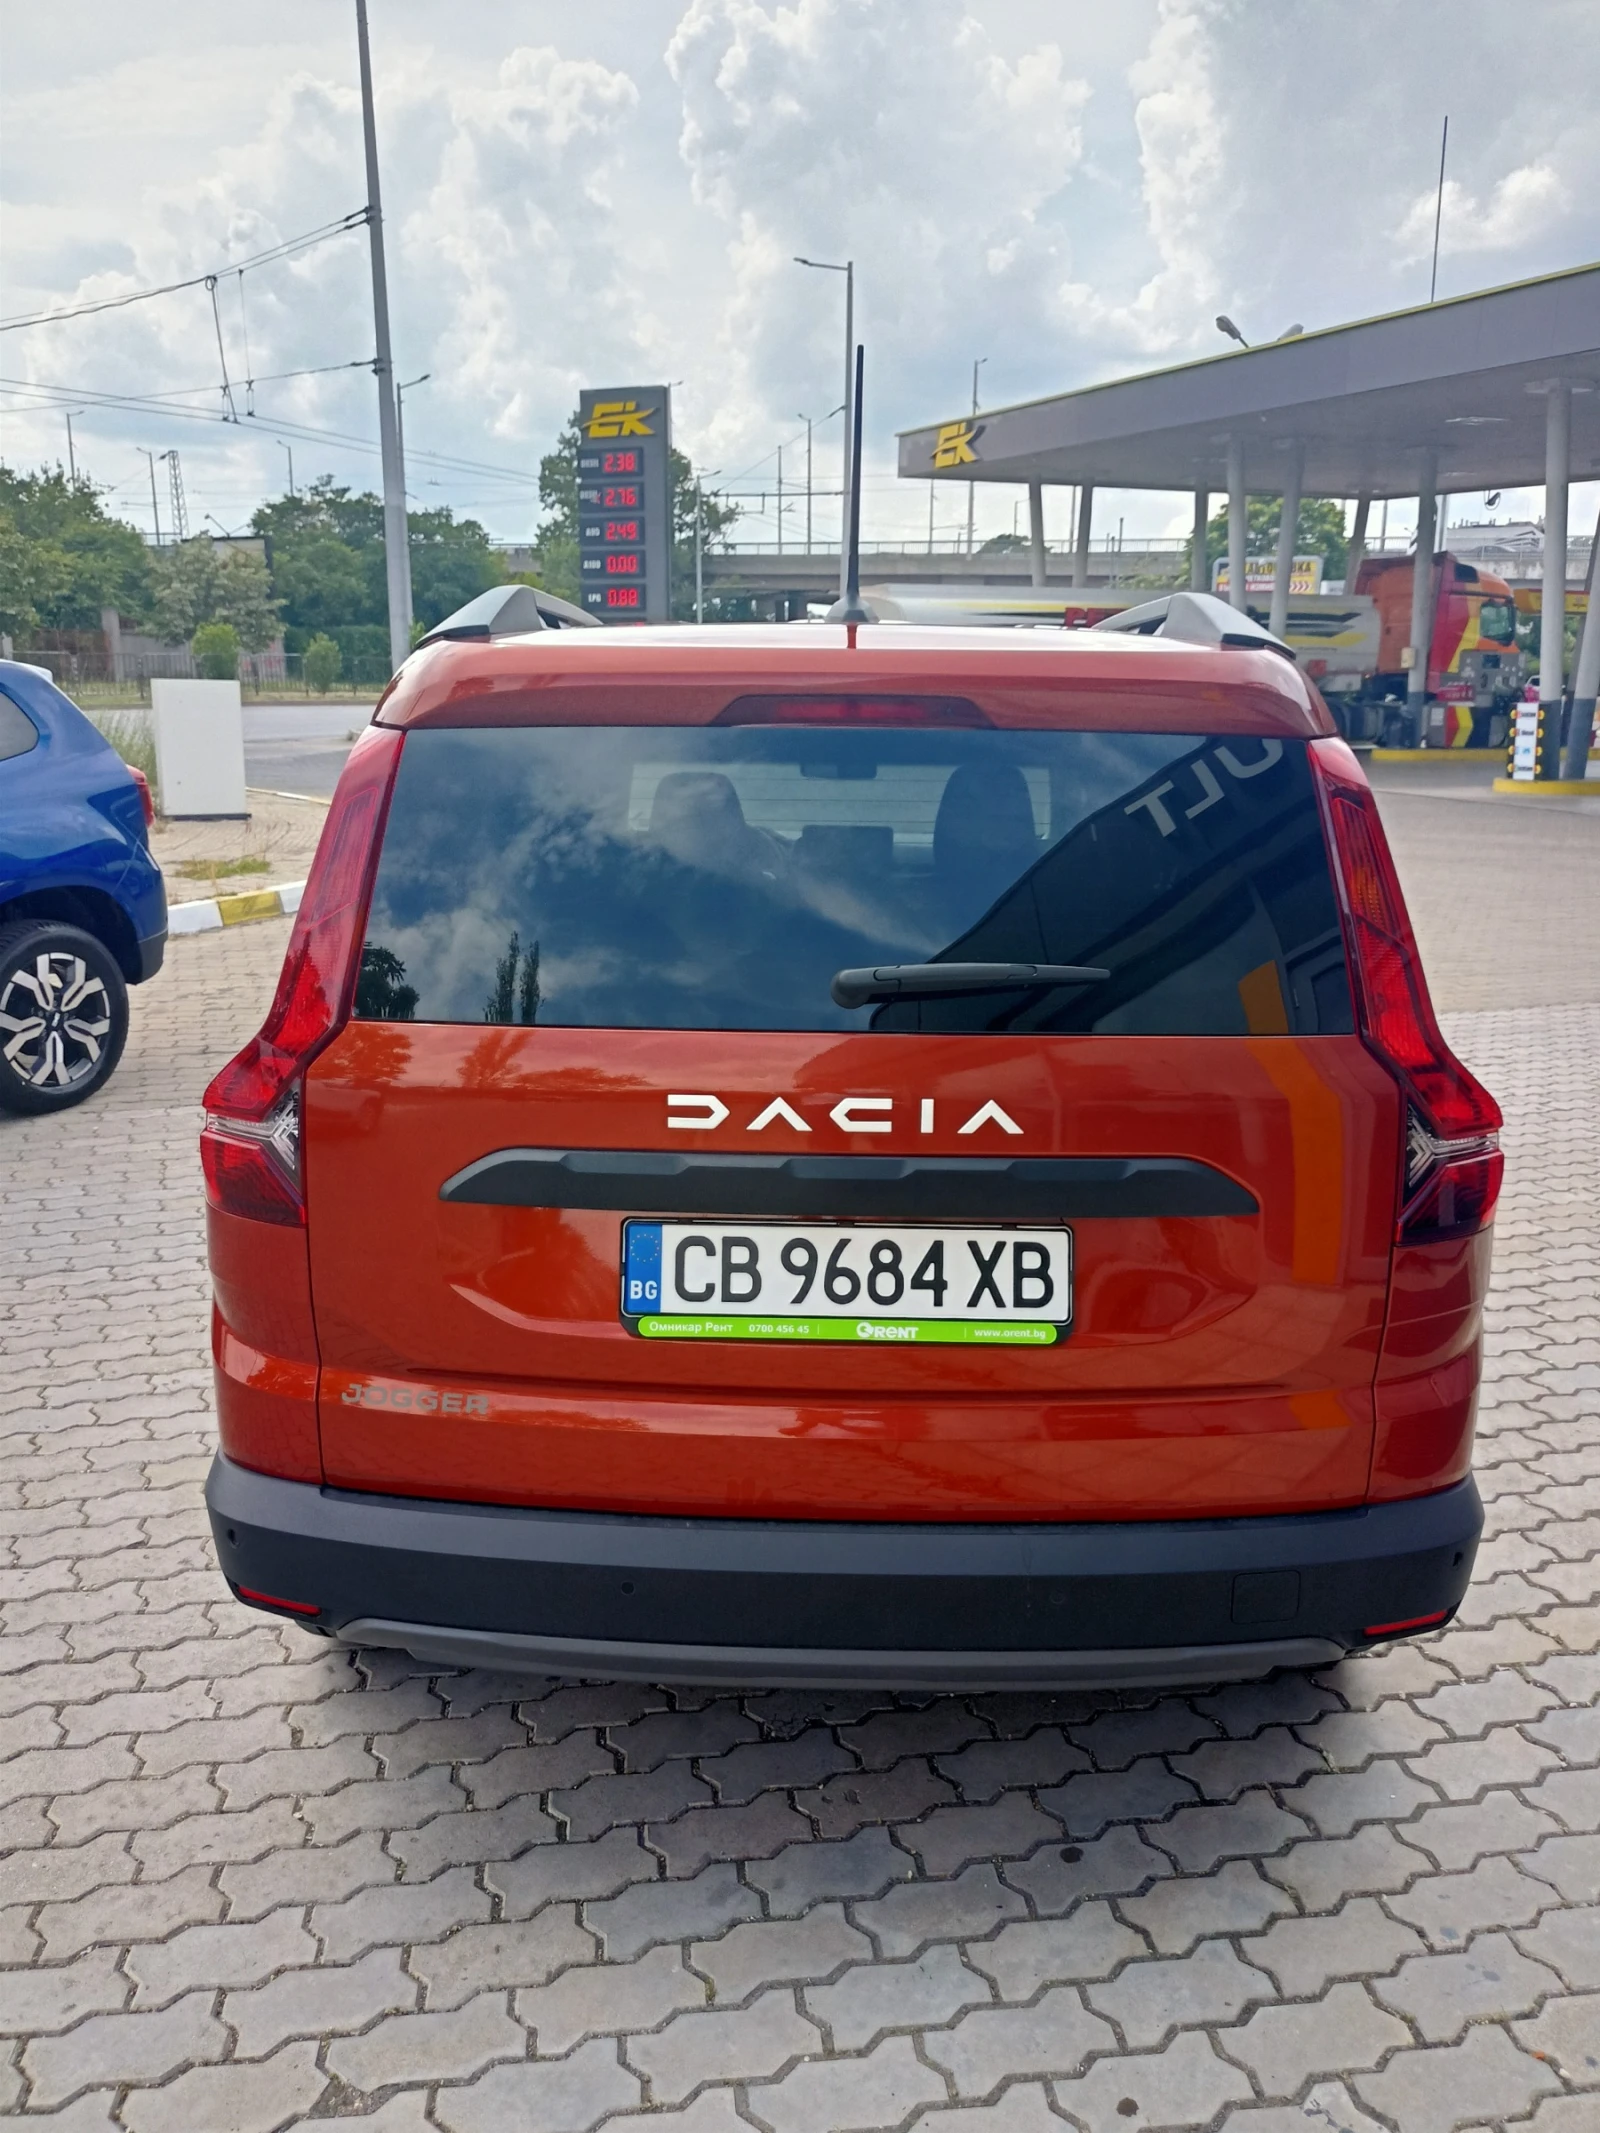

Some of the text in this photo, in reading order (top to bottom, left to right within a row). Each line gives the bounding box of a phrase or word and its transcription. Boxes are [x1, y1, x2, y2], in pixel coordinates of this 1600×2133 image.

[605, 488, 637, 506] 2.76
[606, 522, 637, 540] 2.49
[607, 555, 638, 573] 0.00
[667, 1094, 1025, 1134] DACIA
[674, 1235, 1054, 1308] CB 9684 XB
[630, 1280, 658, 1300] BG
[649, 1321, 810, 1334] Омникар Рент 0700 456 45
[974, 1328, 1046, 1340] www.orent.bg
[341, 1383, 489, 1415] JOGGER
